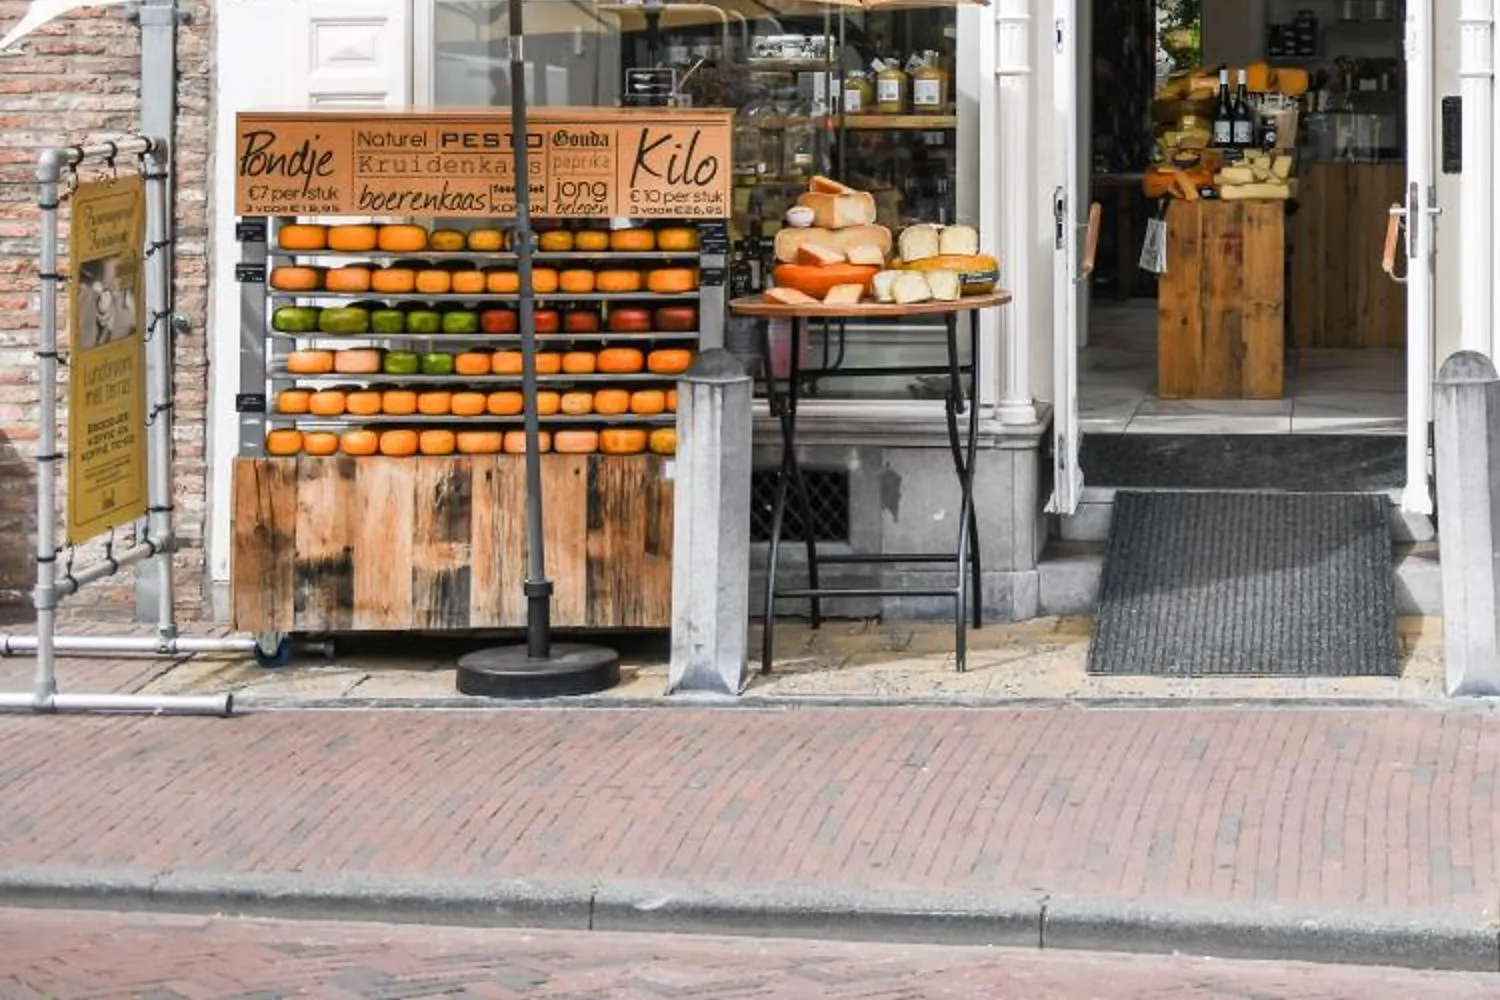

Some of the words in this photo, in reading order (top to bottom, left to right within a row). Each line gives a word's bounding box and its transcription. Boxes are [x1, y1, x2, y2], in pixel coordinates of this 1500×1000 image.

[357, 132, 428, 148] Naturel
[553, 129, 609, 148] Gouda
[239, 130, 335, 197] Pondje
[357, 154, 541, 174] Kruidenkas
[553, 151, 610, 171] paprika
[630, 127, 718, 188] Kilo
[272, 188, 300, 203] per
[306, 187, 339, 201] stuk
[358, 180, 487, 212] boerenkaas
[554, 177, 608, 203] jong
[664, 192, 691, 206] per
[693, 190, 723, 203] stuk
